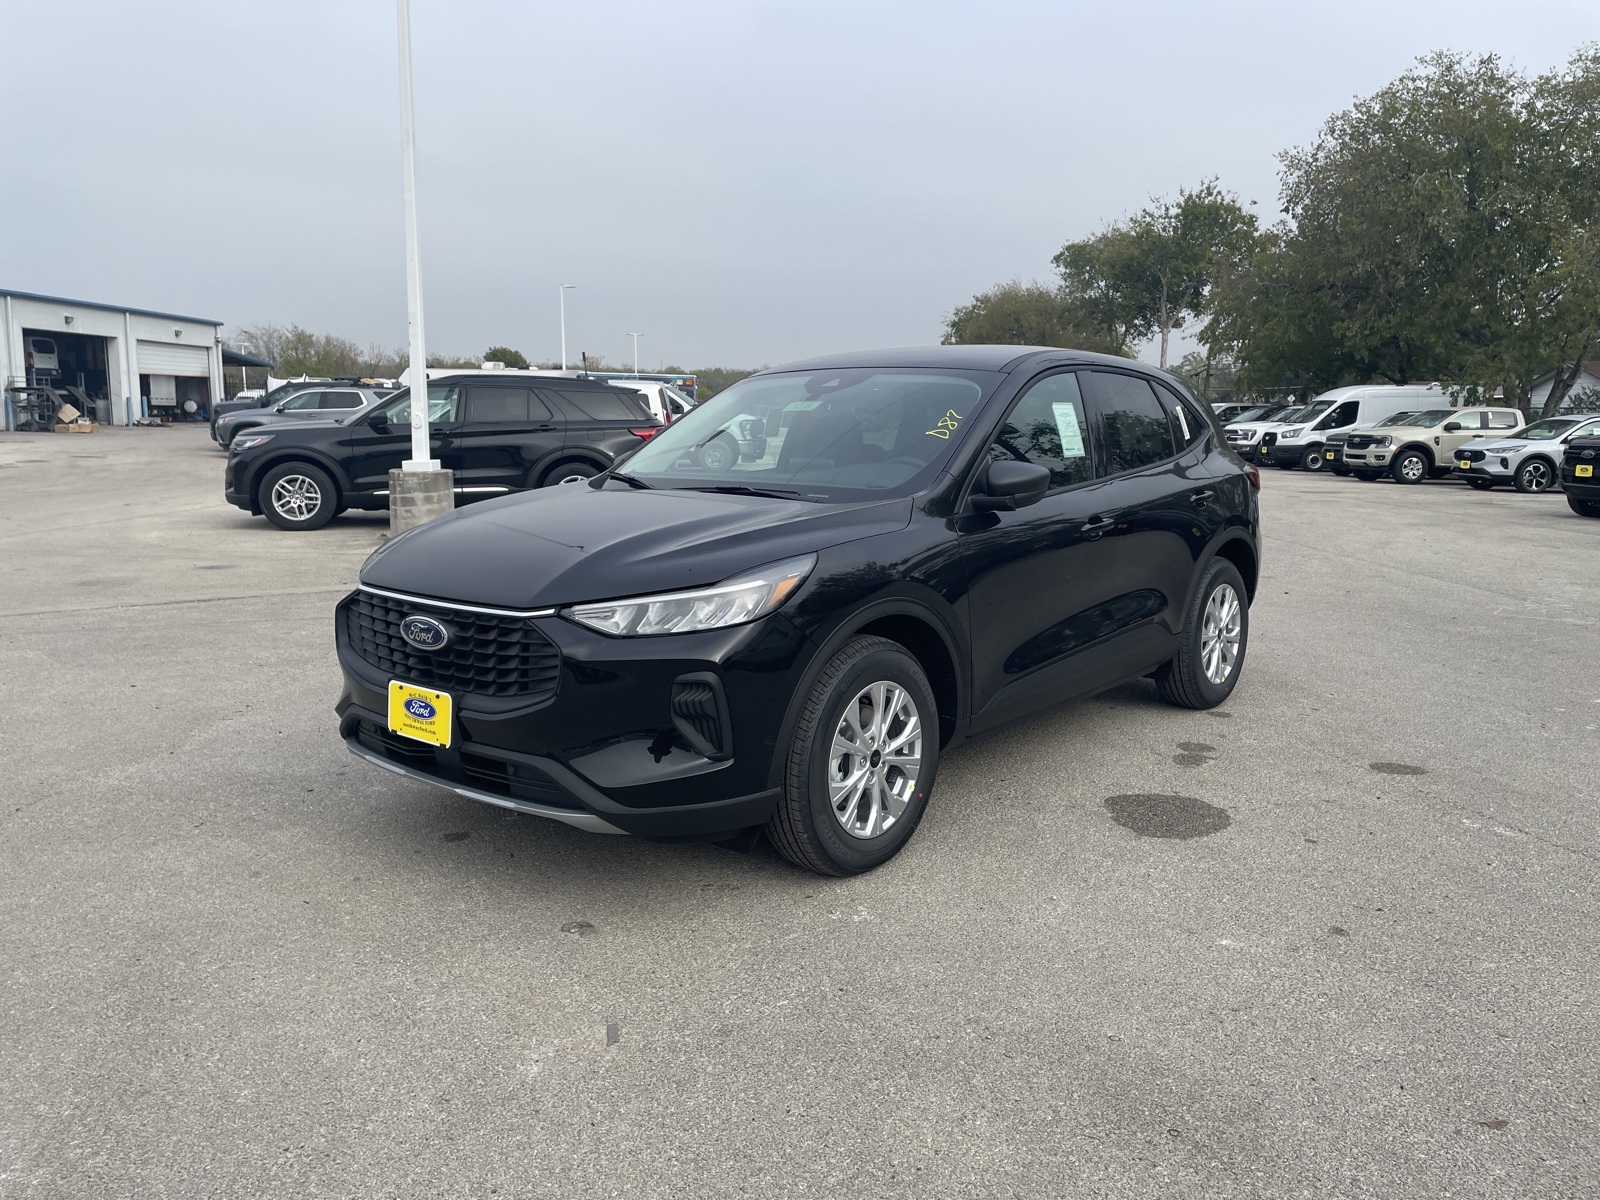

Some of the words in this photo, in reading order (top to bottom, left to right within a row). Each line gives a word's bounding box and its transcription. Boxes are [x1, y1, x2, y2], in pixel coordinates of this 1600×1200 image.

[925, 409, 963, 439] D87
[408, 622, 434, 643] Ford
[409, 700, 430, 717] Ford
